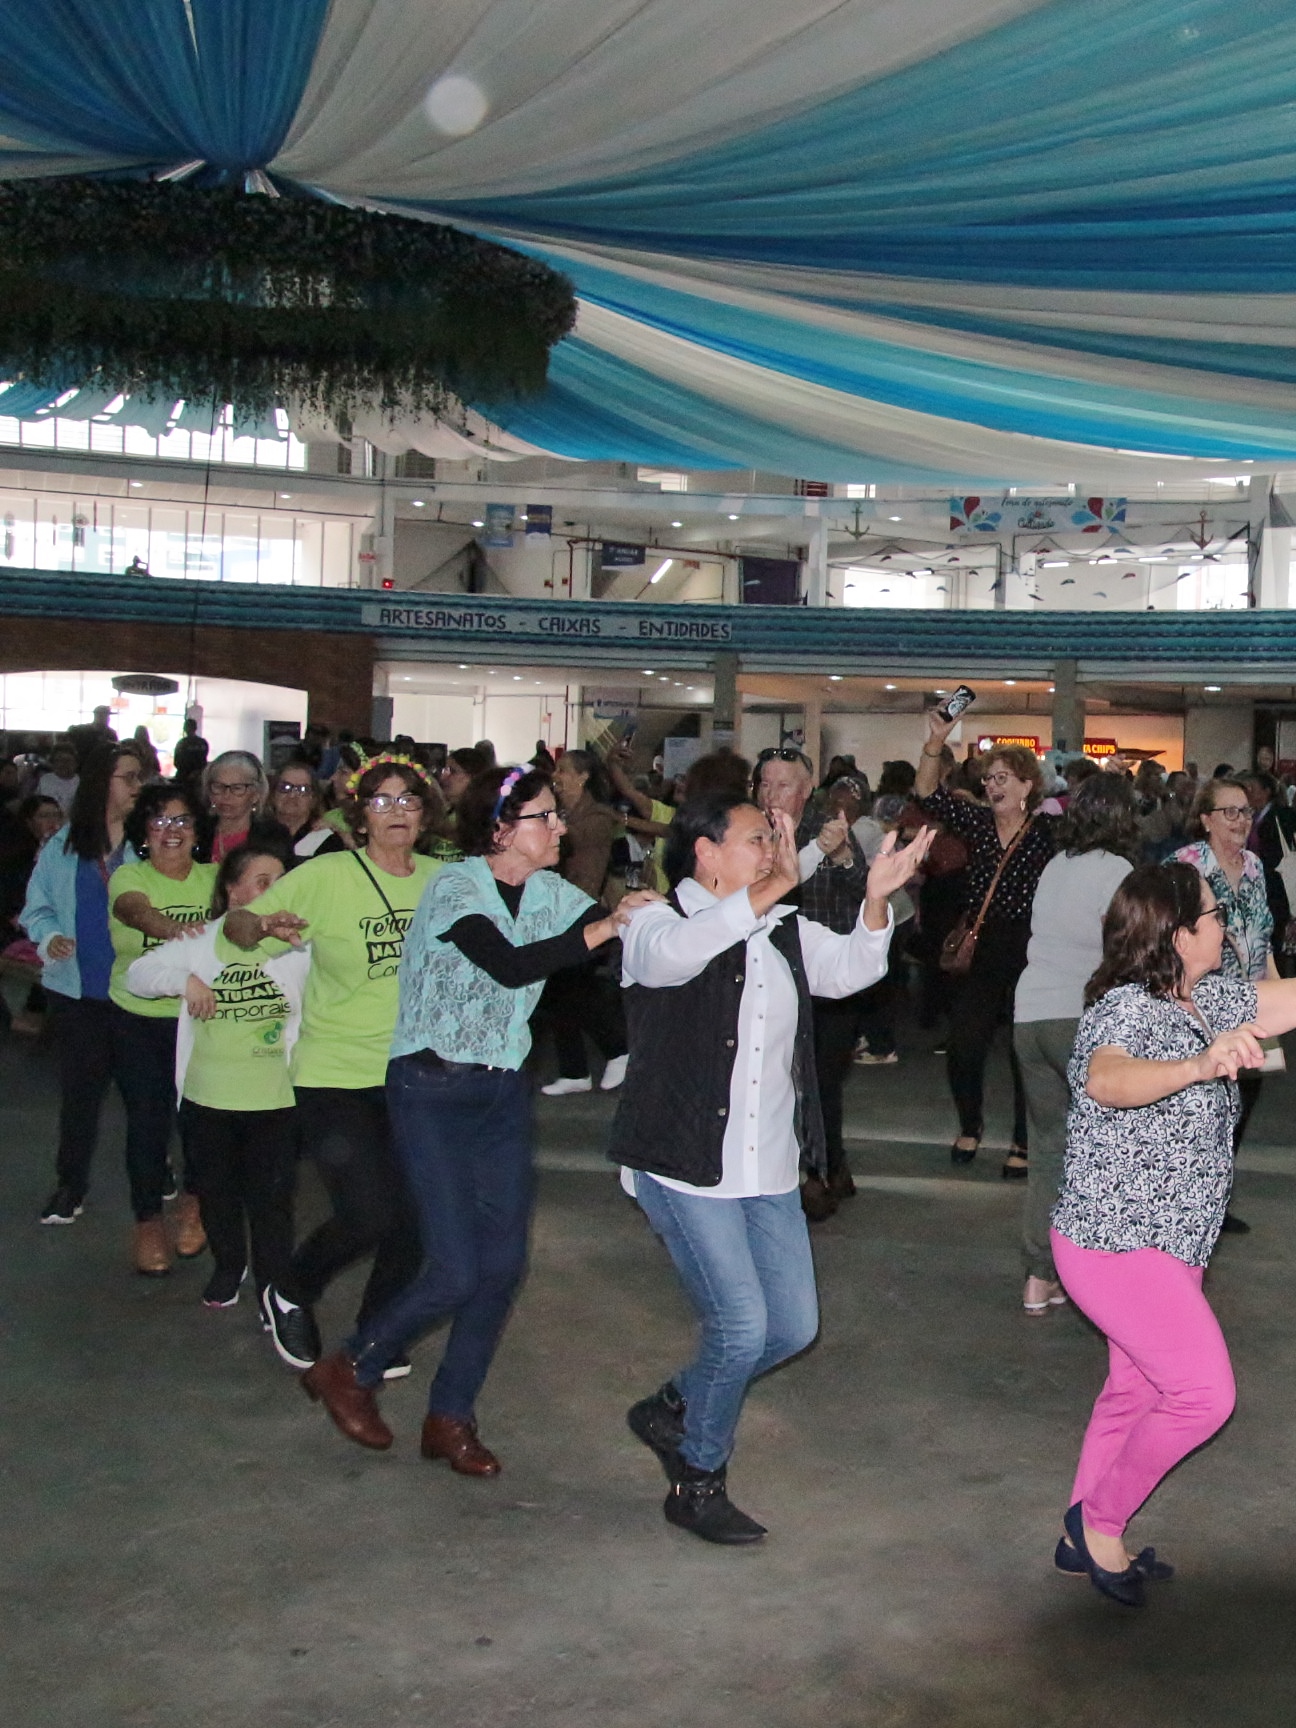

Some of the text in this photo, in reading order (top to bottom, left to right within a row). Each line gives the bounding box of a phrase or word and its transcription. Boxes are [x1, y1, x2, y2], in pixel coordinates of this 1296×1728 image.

[380, 608, 507, 630] ARTESANATOS
[538, 616, 601, 634] CAIXAS
[638, 620, 730, 639] ENTIDADES
[1091, 744, 1116, 755] CHIPS
[212, 981, 285, 1003] ATURAIS
[207, 997, 291, 1023] orporais
